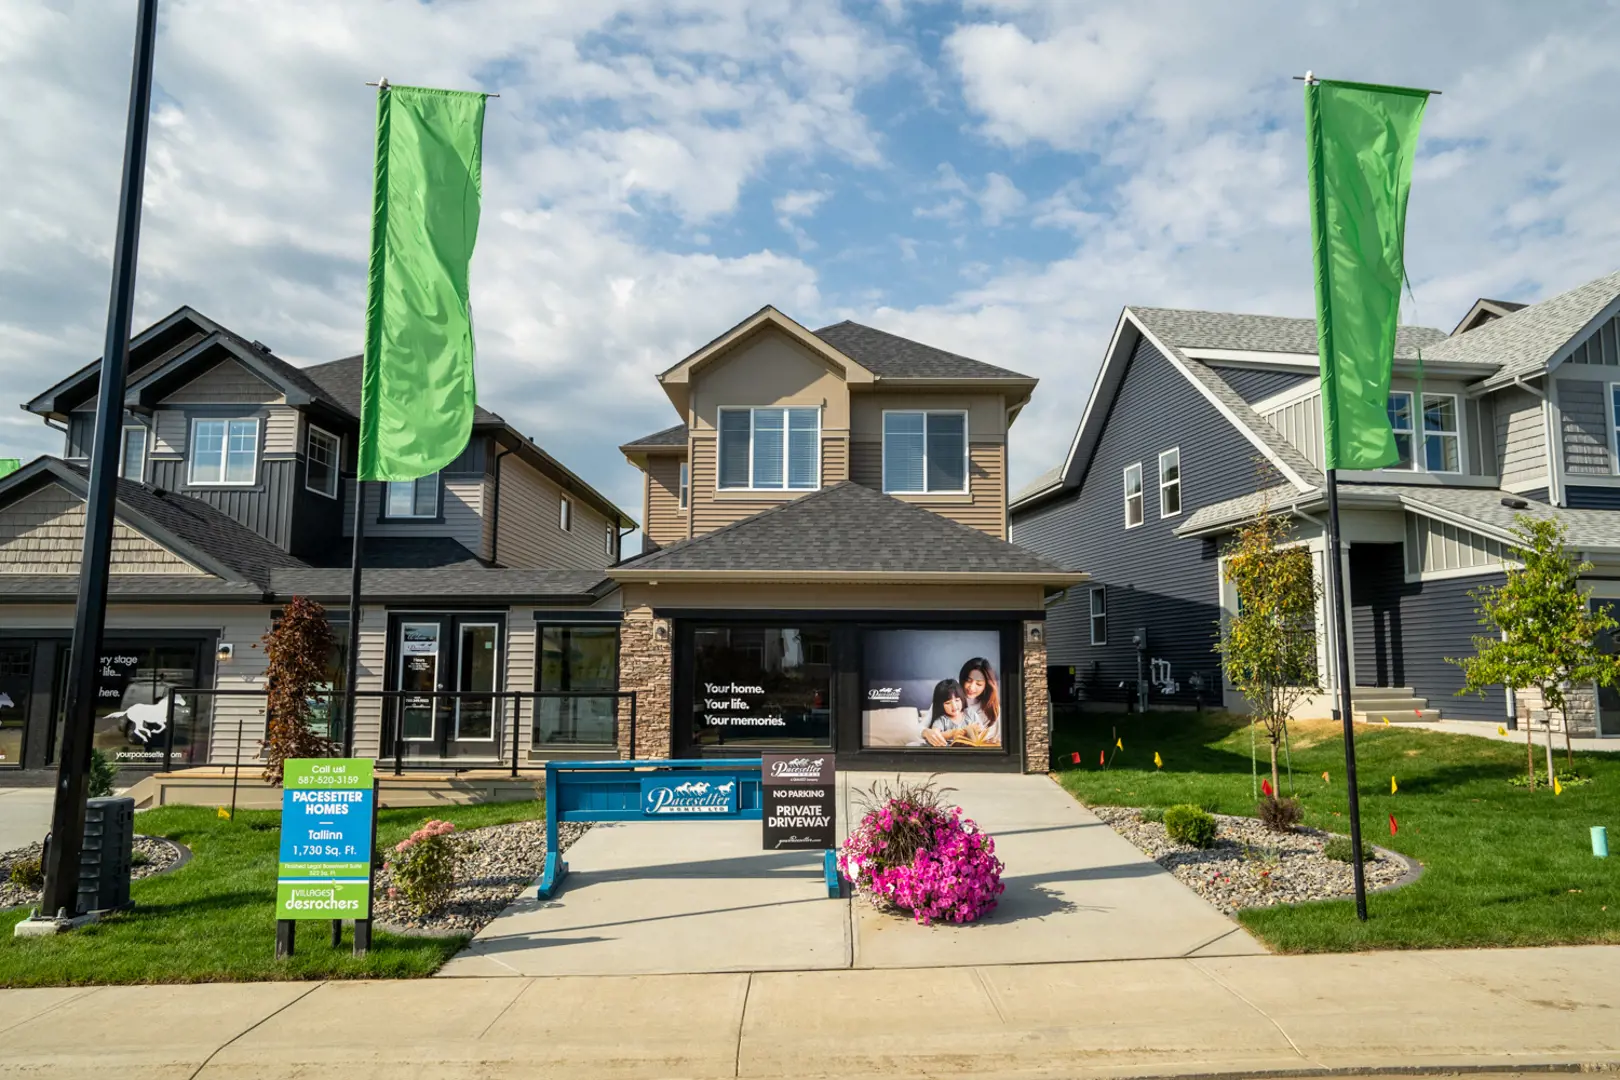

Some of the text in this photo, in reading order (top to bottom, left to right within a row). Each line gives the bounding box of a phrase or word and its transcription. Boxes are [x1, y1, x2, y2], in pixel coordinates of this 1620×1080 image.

[113, 655, 138, 666] stage
[98, 686, 120, 697] here.
[704, 682, 765, 694] Your home.
[704, 698, 750, 710] Your life.
[704, 714, 786, 726] Your memories.
[115, 751, 182, 760] yourpacesetteom
[311, 765, 347, 774] Call us!
[298, 776, 359, 784] 587-520-3159
[292, 791, 363, 802] PACESETTER
[646, 786, 730, 813] Pacesetter
[773, 789, 825, 799] NO PARKING
[305, 804, 349, 815] HOMES
[776, 805, 823, 817] PRIVATE
[768, 816, 831, 828] DRIVEWAY
[308, 829, 343, 841] Tallinn
[293, 845, 358, 858] 1,730 Sq. Ft.
[285, 888, 360, 910] desrochers
[295, 889, 332, 898] VILLAGES
